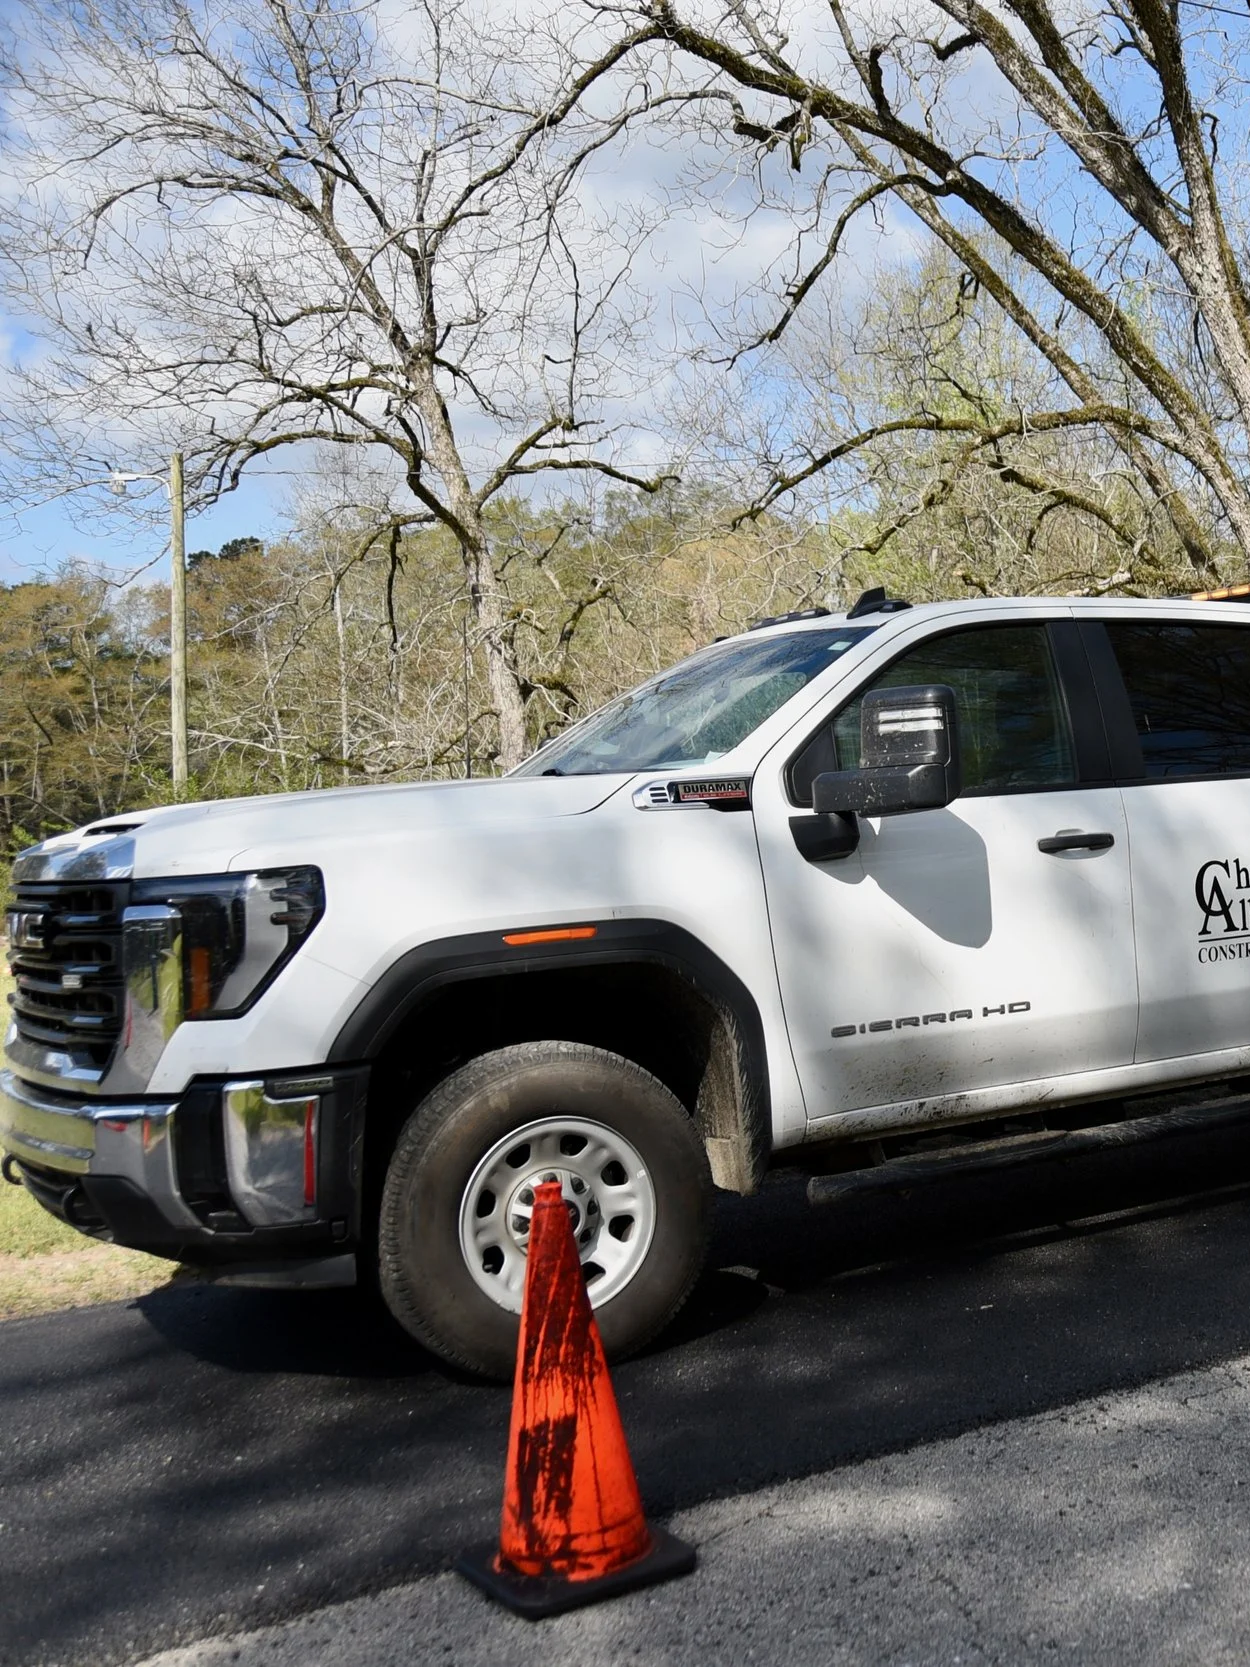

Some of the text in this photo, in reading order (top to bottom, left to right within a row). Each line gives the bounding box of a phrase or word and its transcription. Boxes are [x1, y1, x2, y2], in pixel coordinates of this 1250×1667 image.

[683, 782, 742, 793] DURAMAX
[831, 1001, 1031, 1038] SIERRA HD
